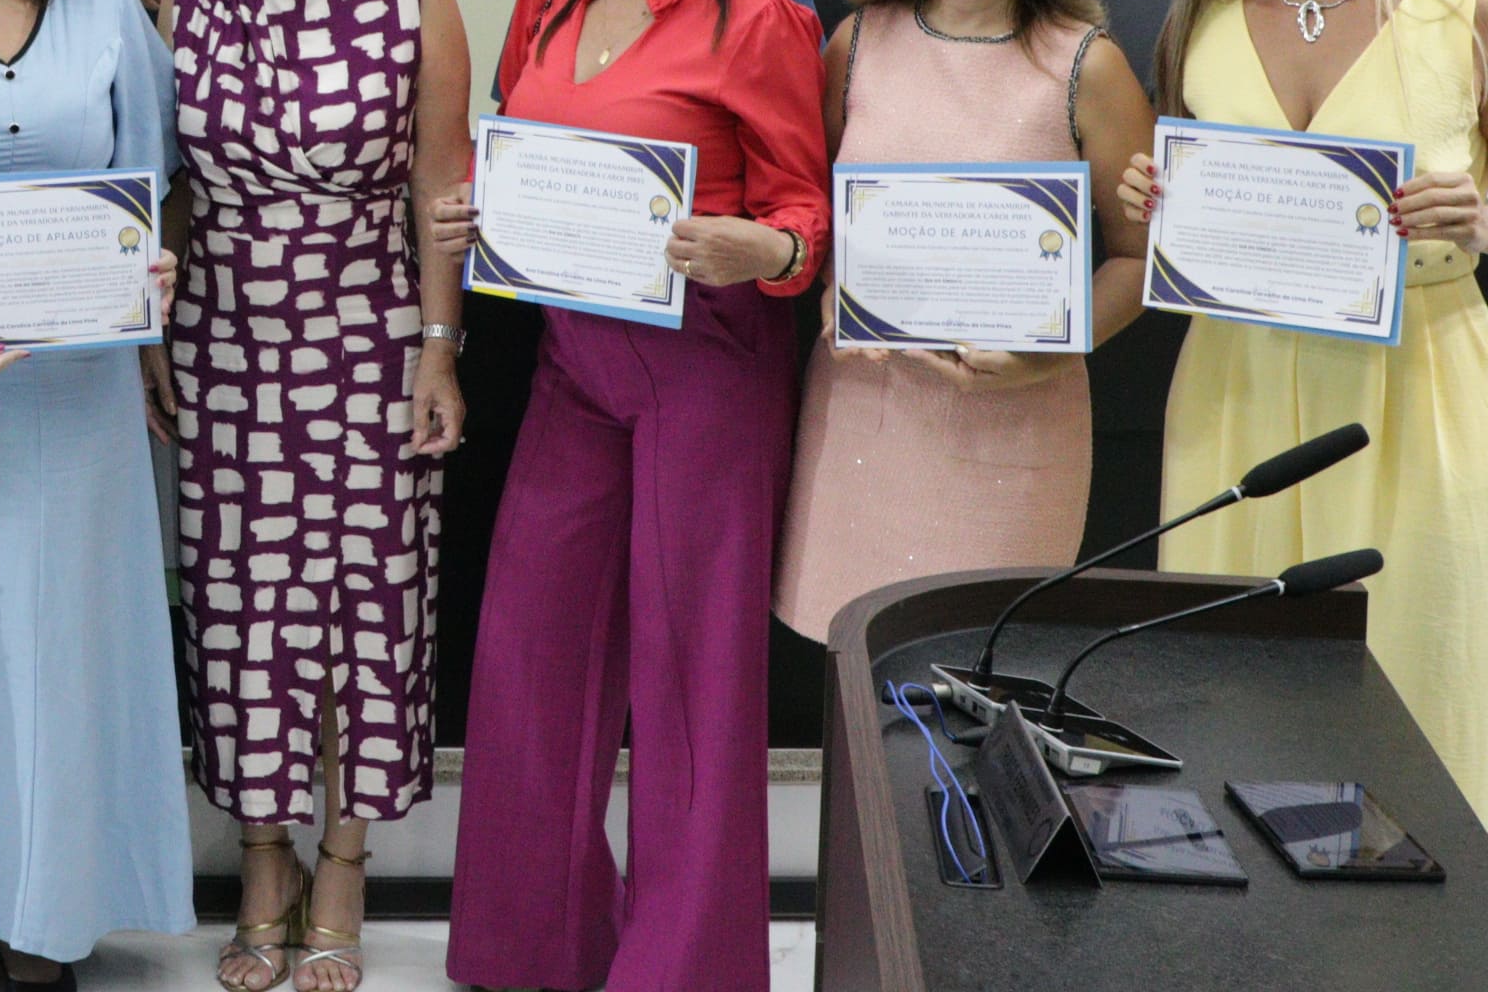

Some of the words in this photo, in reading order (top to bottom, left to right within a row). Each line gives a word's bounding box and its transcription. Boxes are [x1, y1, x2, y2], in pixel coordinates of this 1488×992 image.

[520, 176, 562, 193] MOÇÃO
[566, 183, 578, 193] DE
[582, 186, 639, 202] APLAUSOS
[1204, 187, 1253, 204] MOÇÃO
[1257, 193, 1272, 204] DE
[1277, 195, 1344, 212] APLAUSOS
[27, 233, 41, 243] DE
[46, 229, 107, 242] APLAUSOS
[889, 226, 936, 239] MOÇÃO
[941, 228, 956, 237] DE
[961, 229, 1027, 239] APLAUSOS
